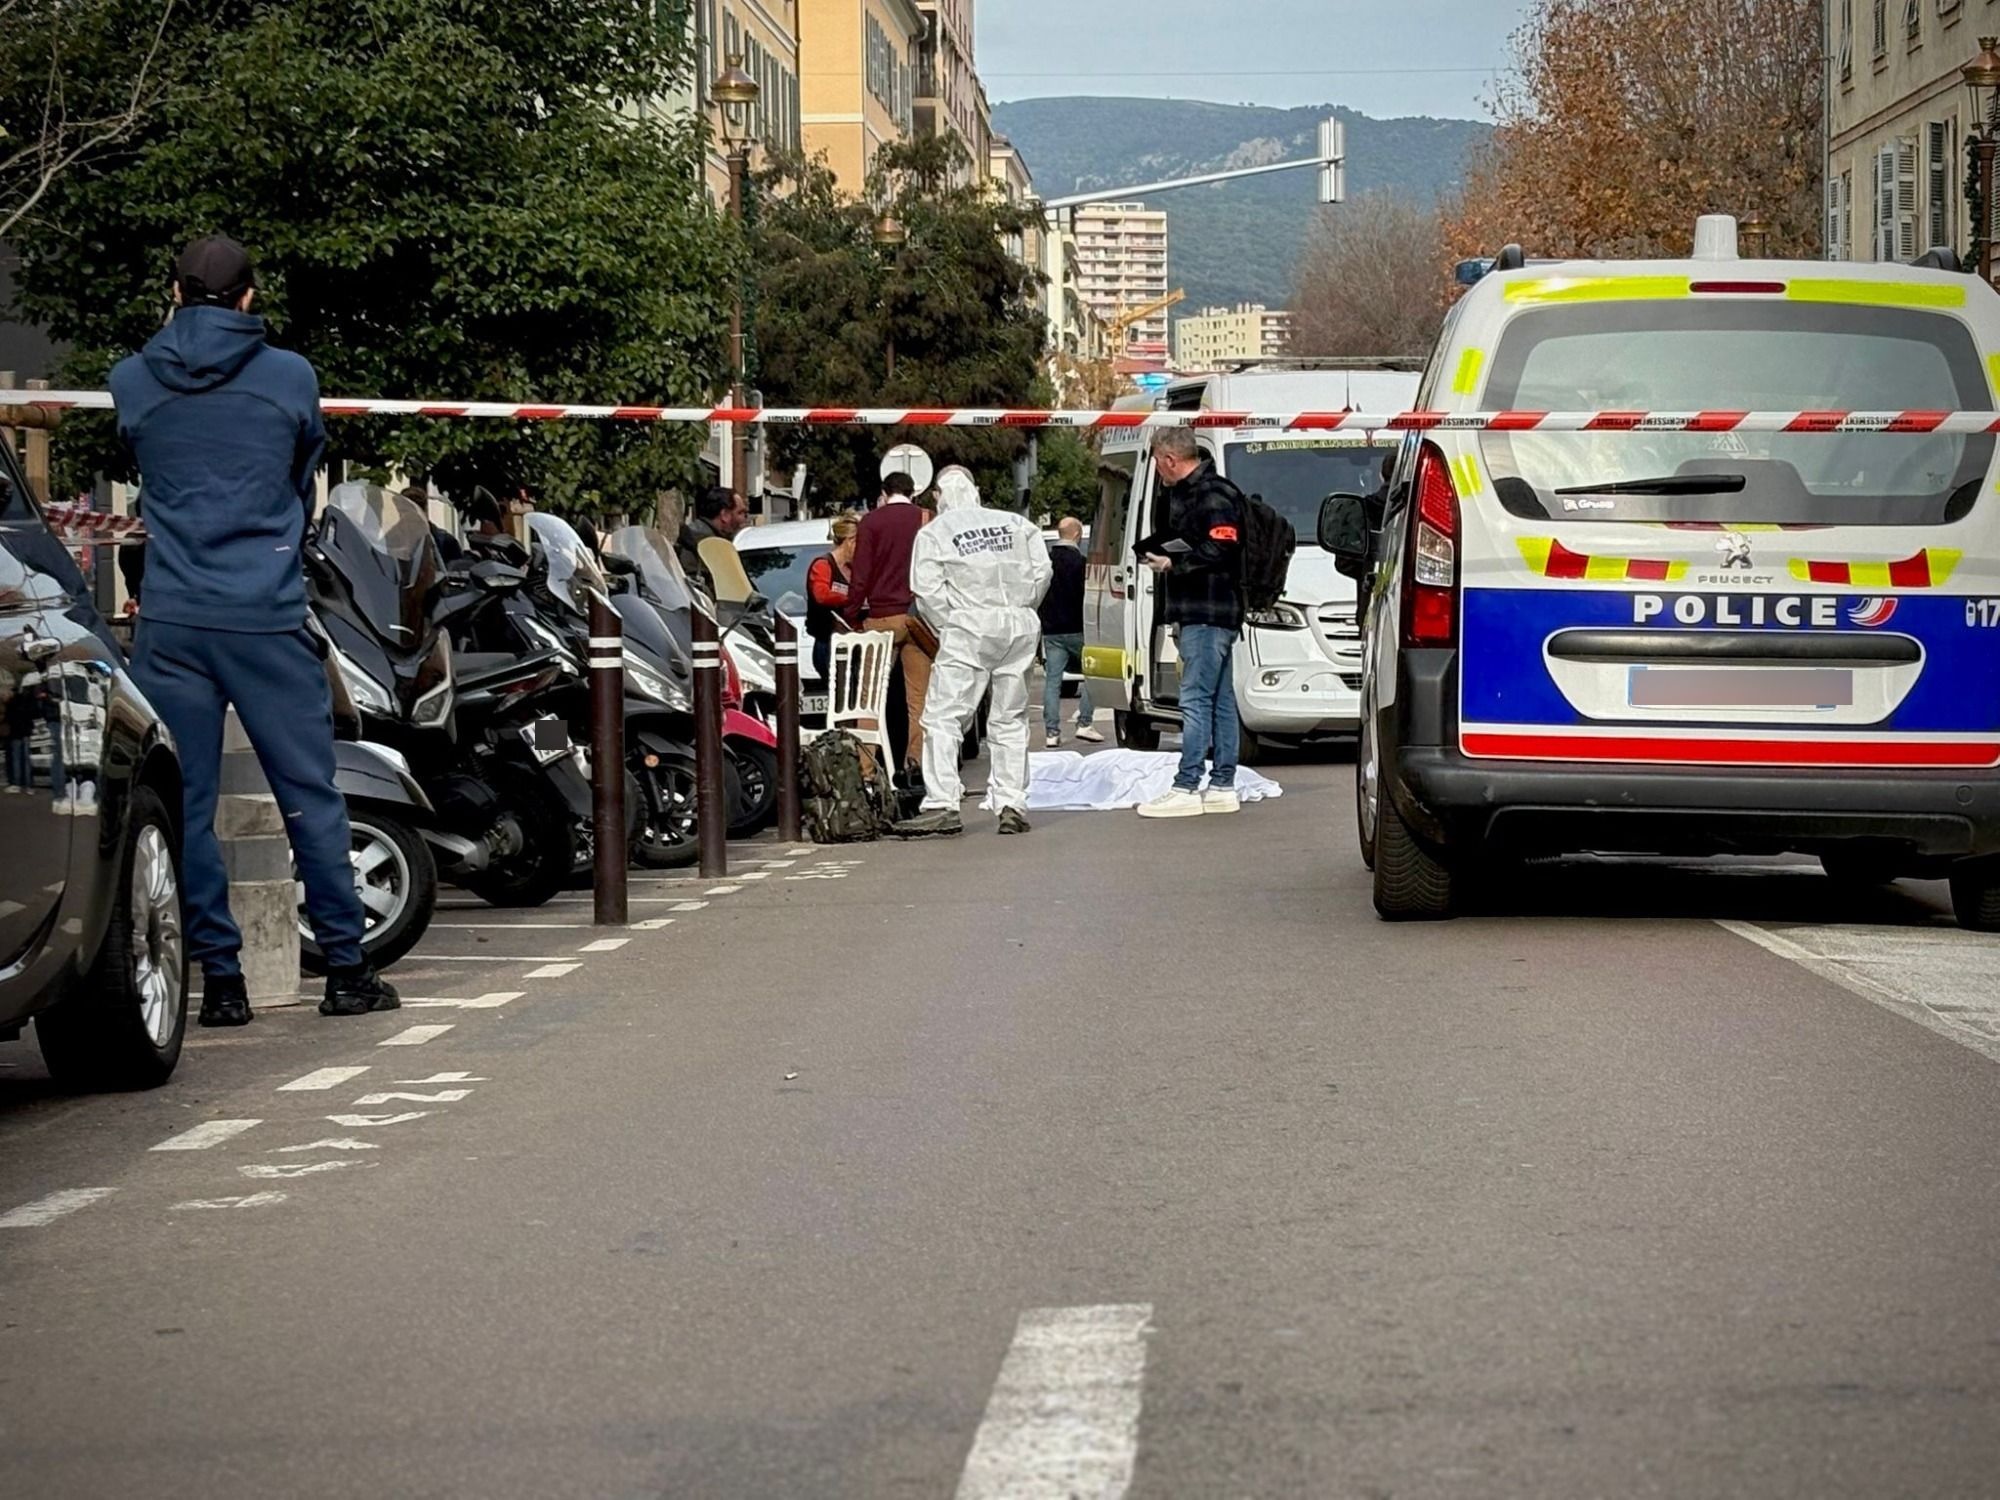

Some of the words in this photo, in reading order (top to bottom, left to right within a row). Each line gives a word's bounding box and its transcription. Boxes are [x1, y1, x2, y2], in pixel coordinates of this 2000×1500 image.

[1698, 575, 1774, 585] PEUGEOT
[1633, 594, 1838, 626] POLICE
[1977, 599, 2000, 628] 17
